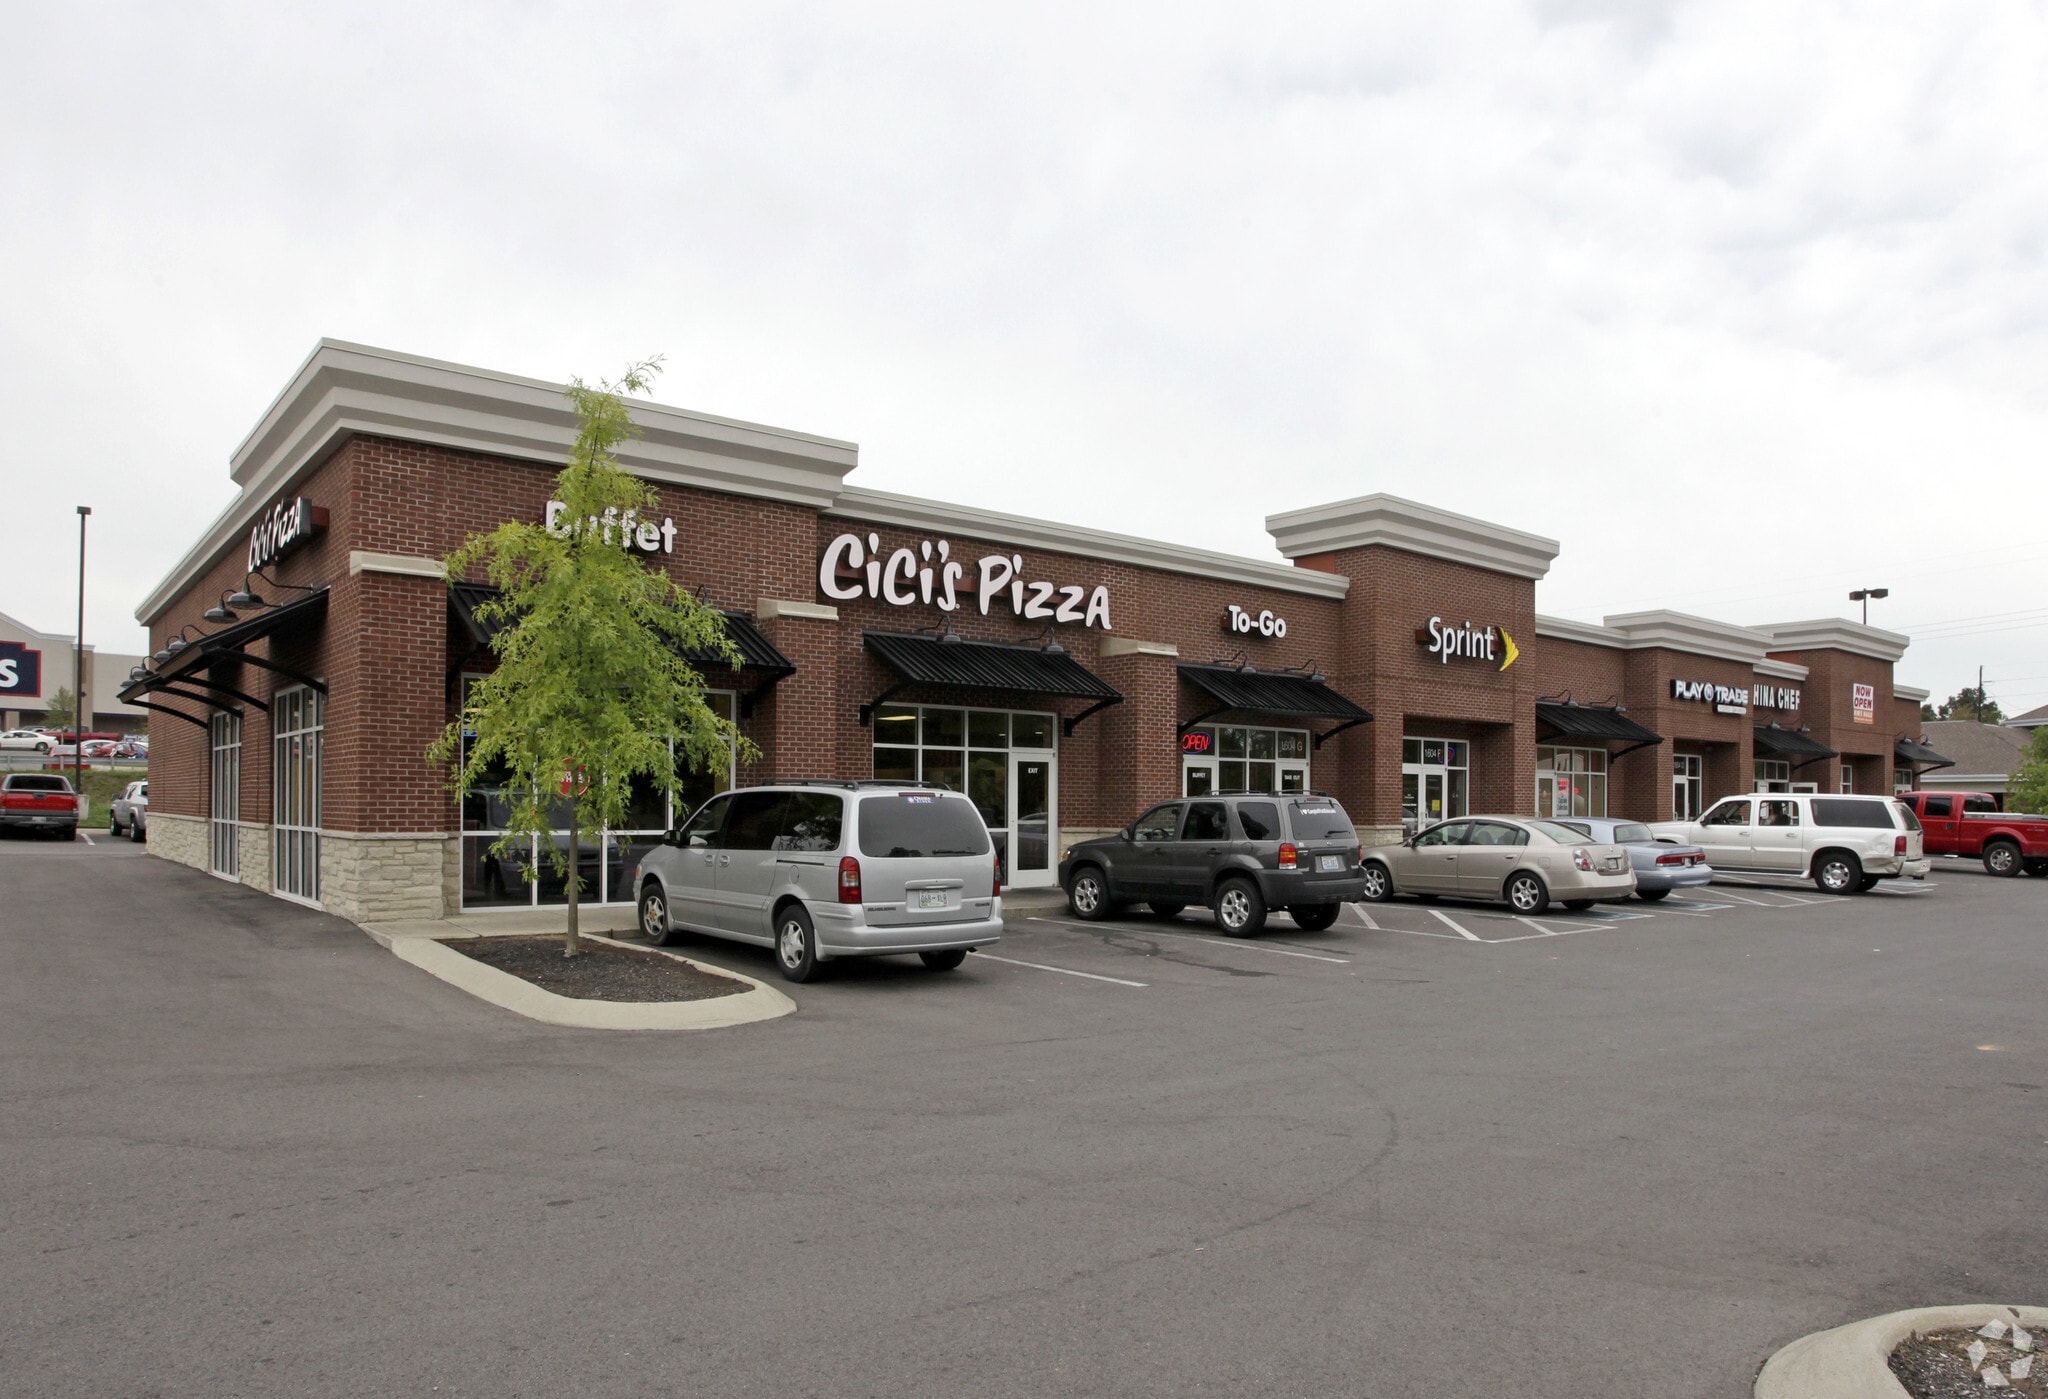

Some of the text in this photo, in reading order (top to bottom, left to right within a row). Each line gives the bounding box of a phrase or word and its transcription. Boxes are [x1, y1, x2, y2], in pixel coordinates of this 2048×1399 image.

[820, 532, 963, 612] CiCi's
[1228, 604, 1287, 638] To-Go
[1429, 616, 1494, 664] Sprint
[1675, 680, 1704, 700] PLAY
[1715, 685, 1749, 705] TRADE
[1753, 684, 1800, 711] HINA CHEF
[1854, 697, 1872, 710] OPEN
[1856, 685, 1871, 698] NOW
[1182, 734, 1209, 751] OPEN
